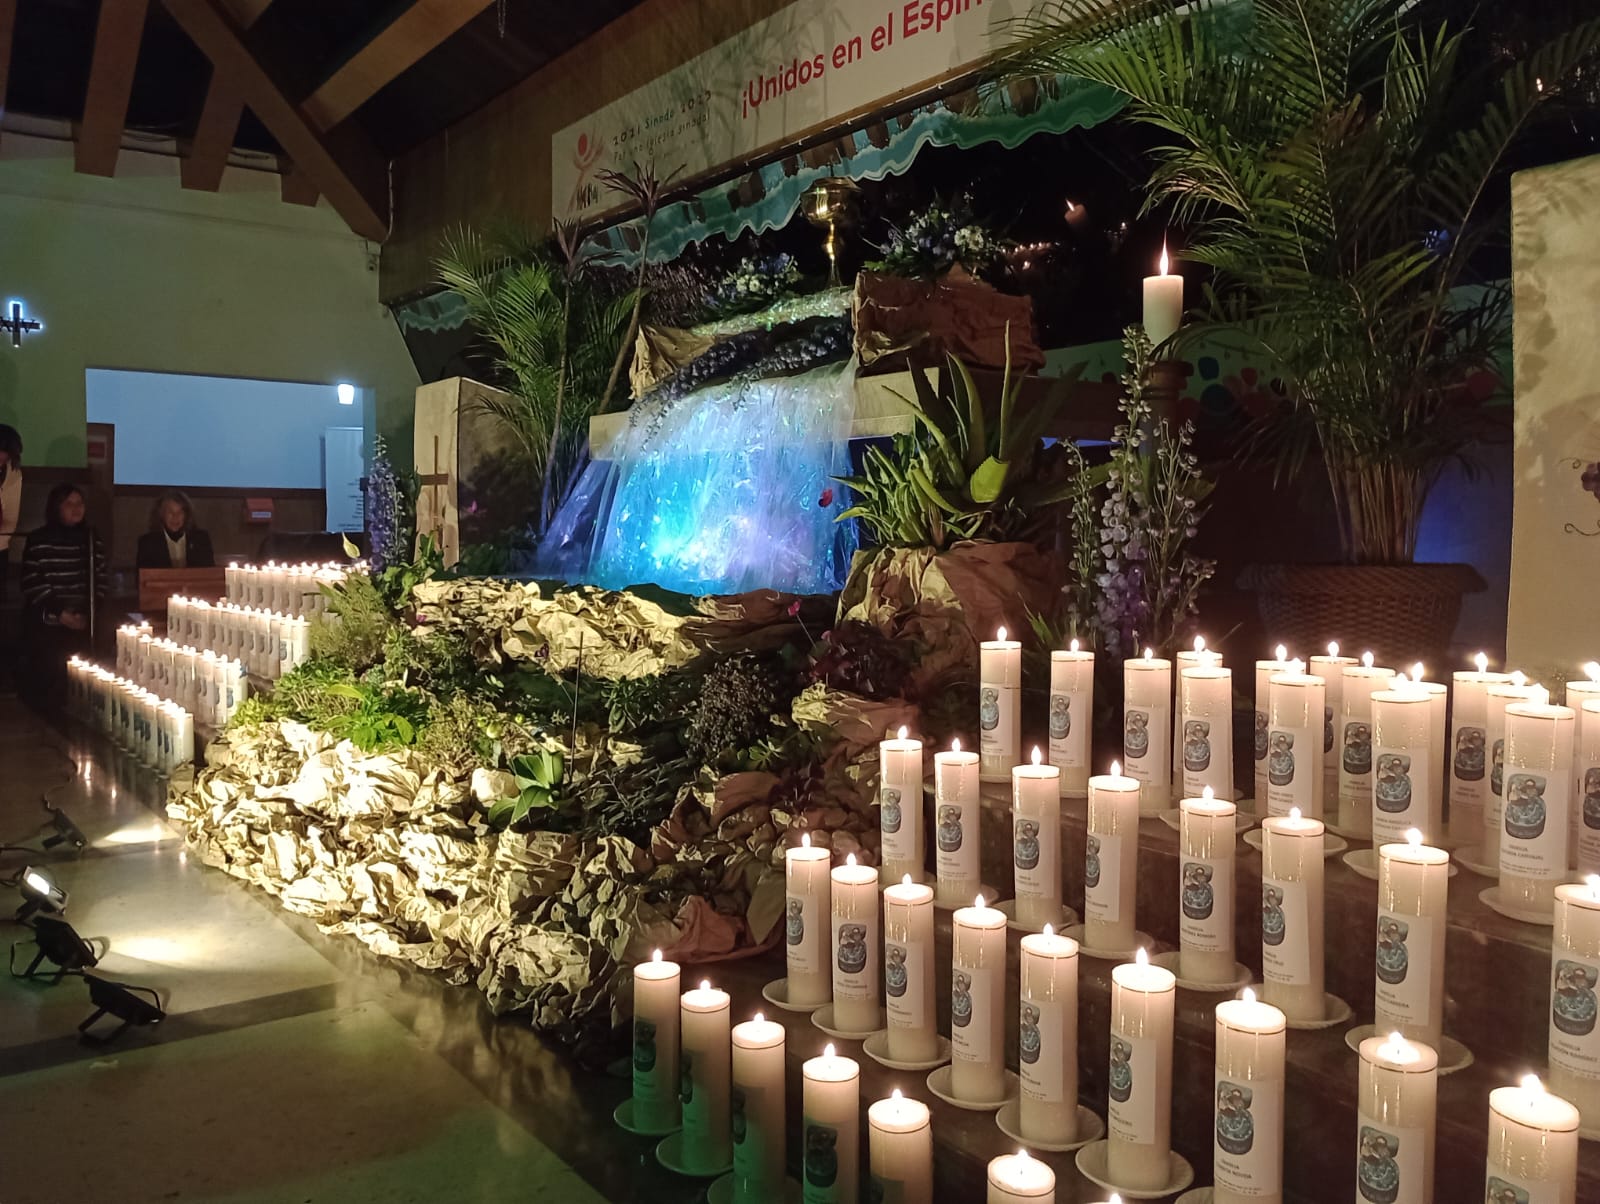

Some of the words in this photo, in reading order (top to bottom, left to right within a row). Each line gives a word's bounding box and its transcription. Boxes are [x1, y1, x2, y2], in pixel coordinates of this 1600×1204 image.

[742, 54, 825, 119] ¡Unidos
[832, 36, 862, 69] en
[870, 12, 893, 51] el
[903, 0, 983, 38] Esp
[612, 125, 641, 146] 2021
